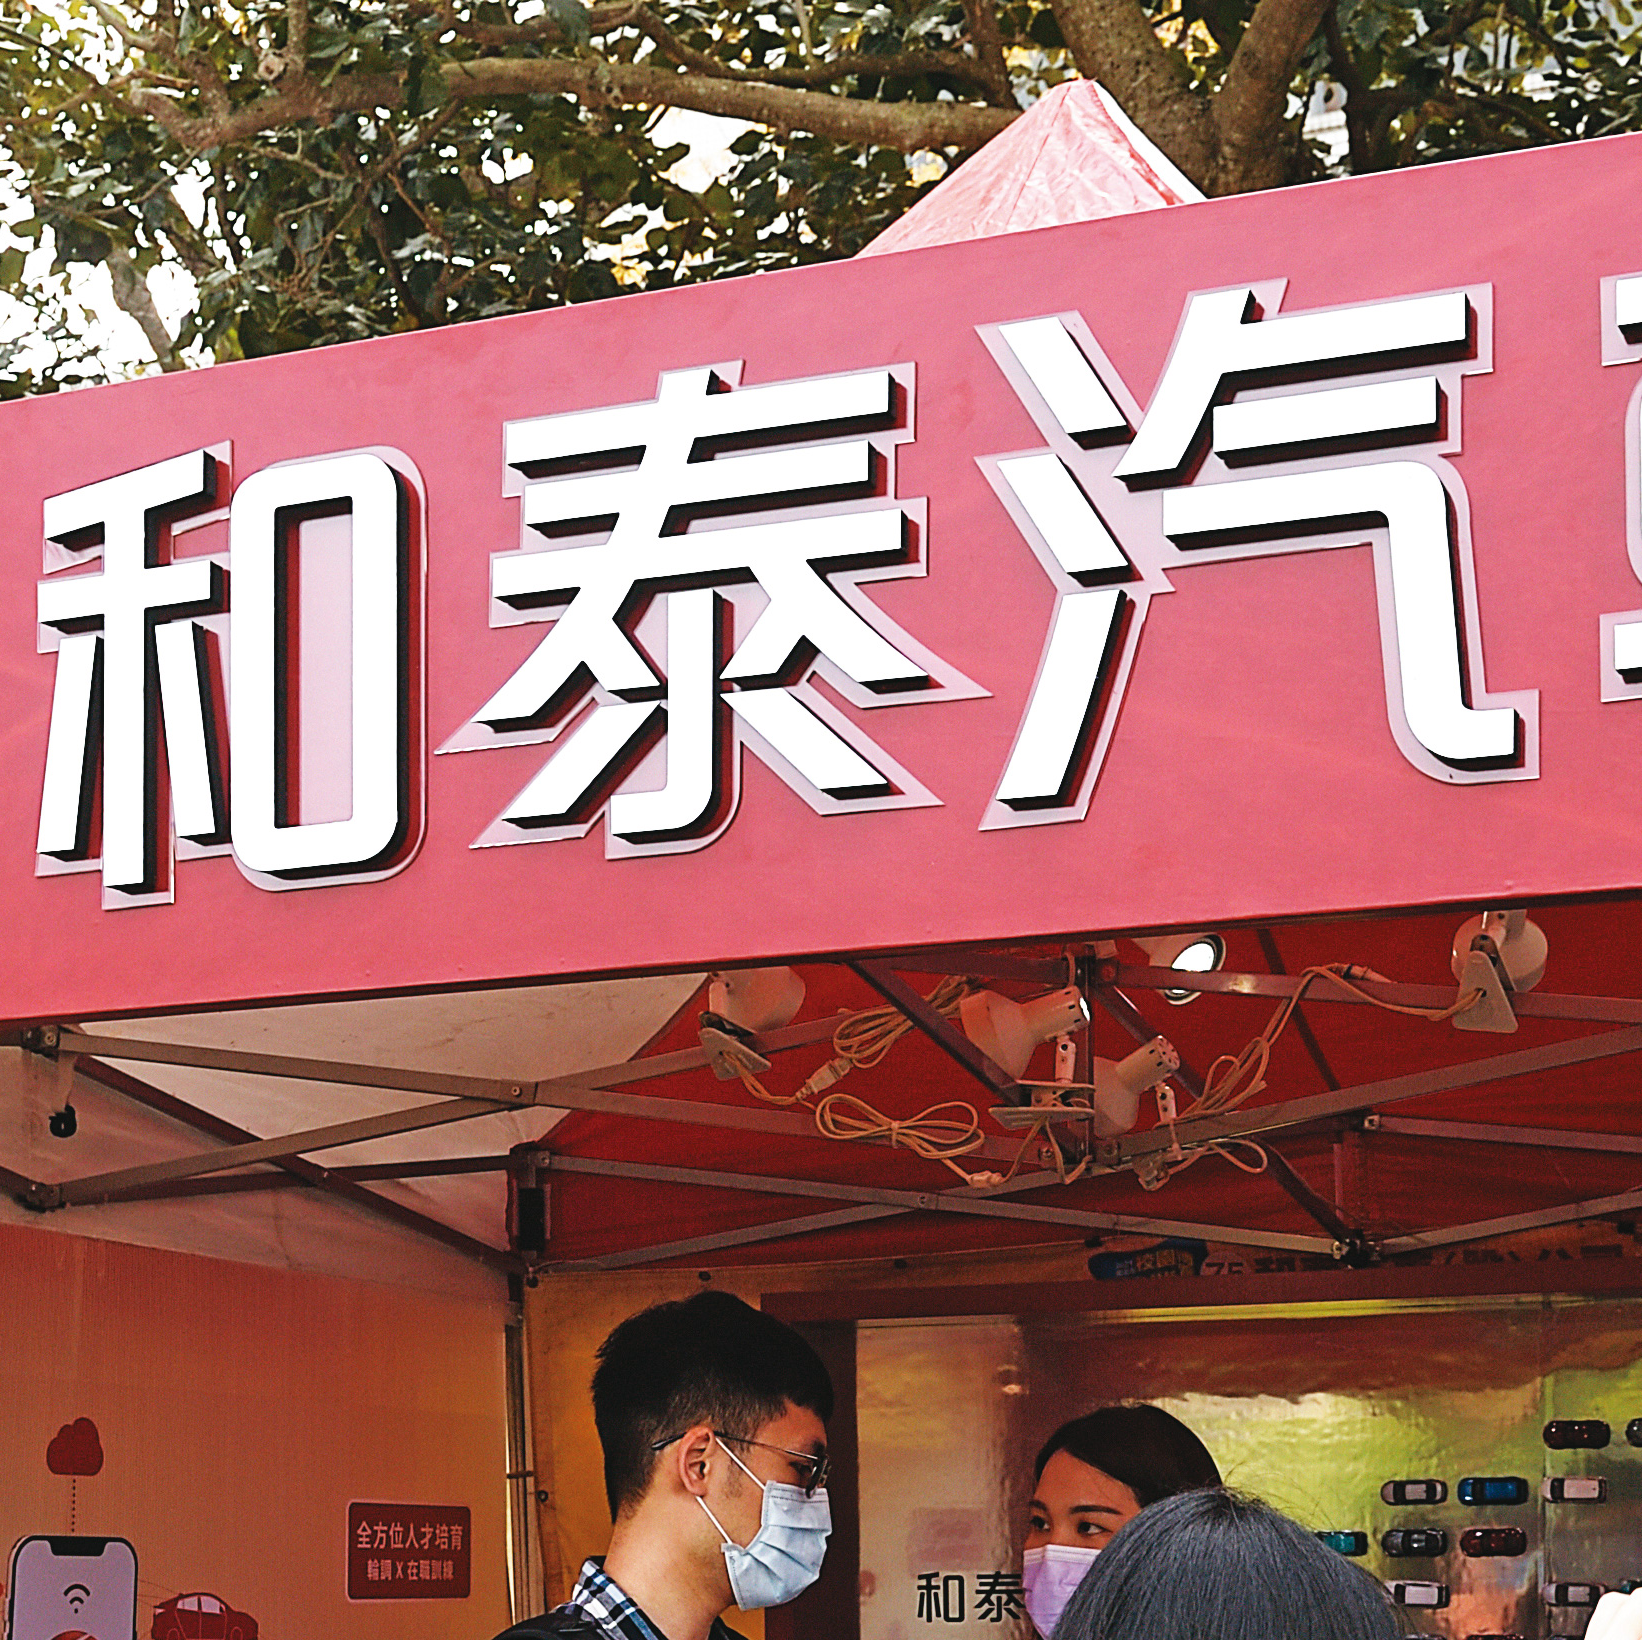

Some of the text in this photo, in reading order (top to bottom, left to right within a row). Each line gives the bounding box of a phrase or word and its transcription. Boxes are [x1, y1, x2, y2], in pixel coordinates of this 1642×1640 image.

[357, 1520, 463, 1551] 全方位人才培育
[914, 1570, 1027, 1623] 和泰
